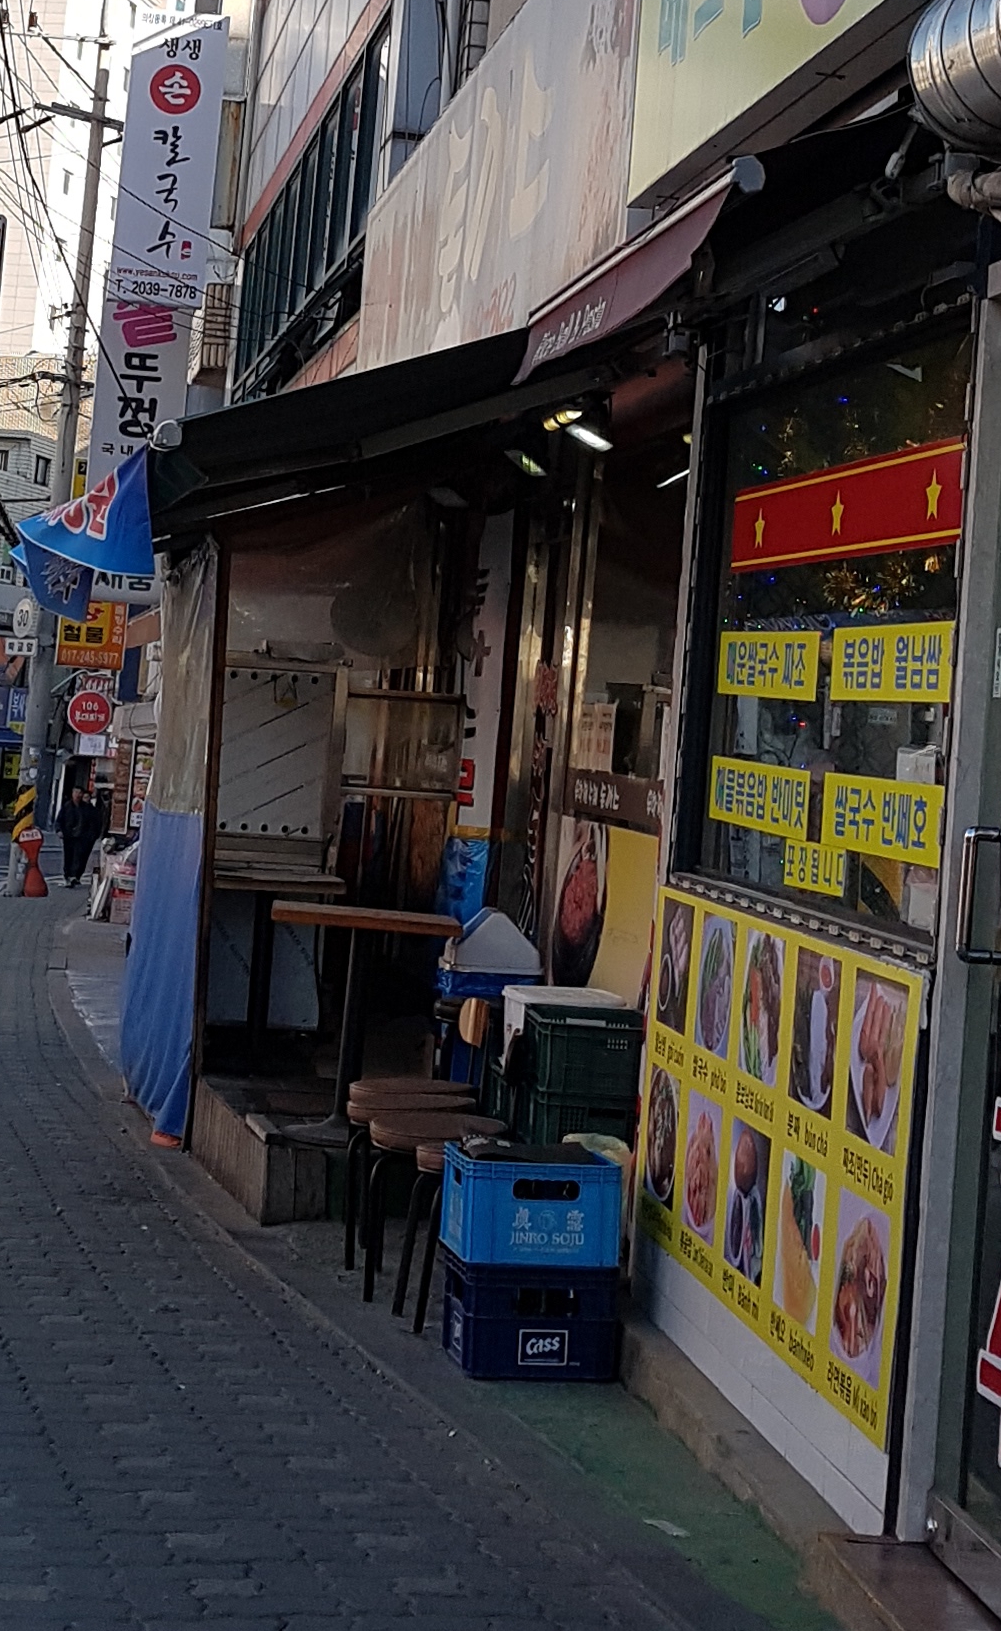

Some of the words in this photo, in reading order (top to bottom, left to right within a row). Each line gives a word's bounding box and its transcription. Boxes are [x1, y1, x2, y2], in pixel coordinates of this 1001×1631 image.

[159, 36, 202, 61] 생생
[132, 281, 197, 300] 2039-7878
[17, 608, 29, 627] 30
[843, 637, 884, 690] 볶음밥
[895, 635, 942, 690] 월남쌈
[82, 701, 99, 712] 106
[835, 785, 876, 842] 쌀국수
[509, 1230, 548, 1245] JINRO
[551, 1232, 585, 1246] SOJU
